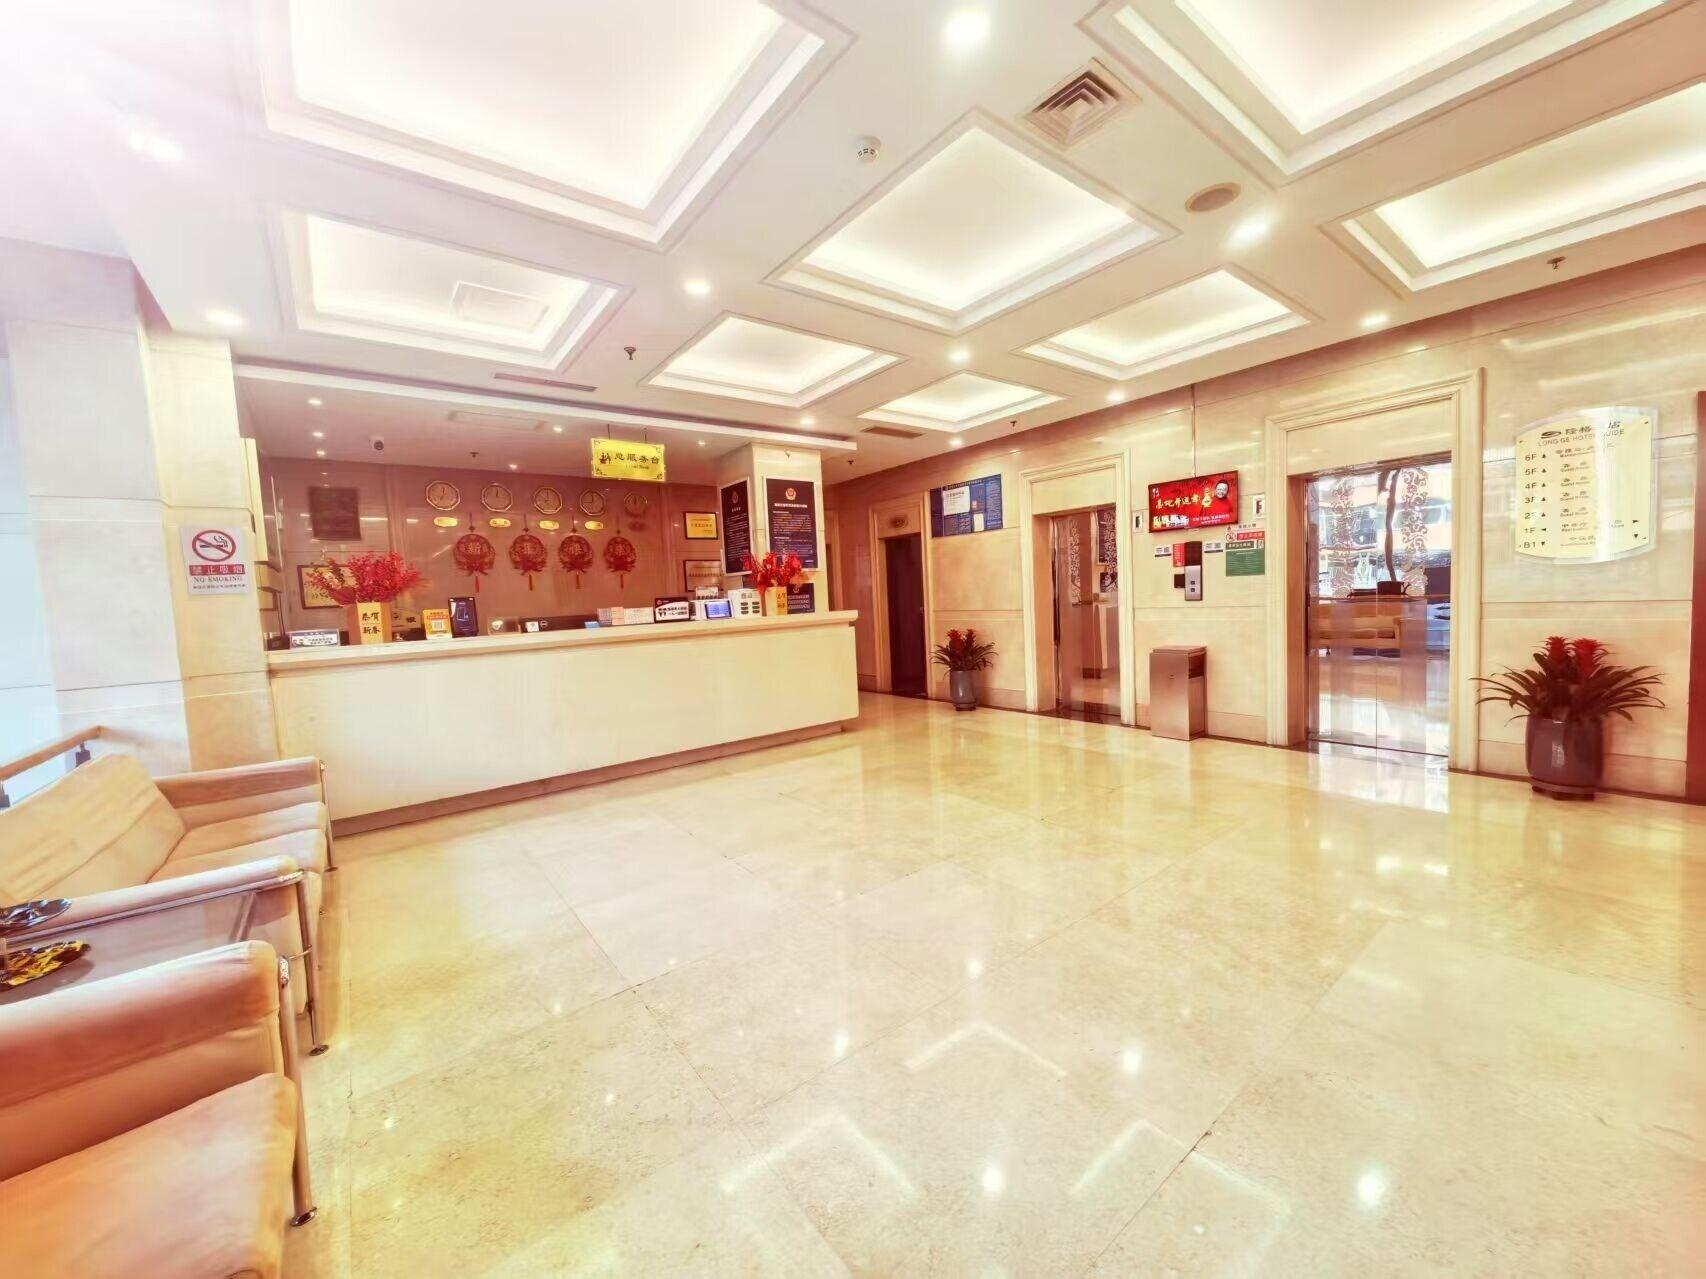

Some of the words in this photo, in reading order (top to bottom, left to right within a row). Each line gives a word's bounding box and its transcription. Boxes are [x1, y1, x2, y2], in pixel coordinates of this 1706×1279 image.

[614, 452, 660, 465] 总服务台
[1524, 453, 1537, 462] 6F
[1524, 467, 1537, 476] 5F
[1524, 482, 1537, 490] 4F
[1524, 496, 1537, 504] 3F
[1523, 541, 1536, 549] B1
[207, 575, 243, 584] SMOKING
